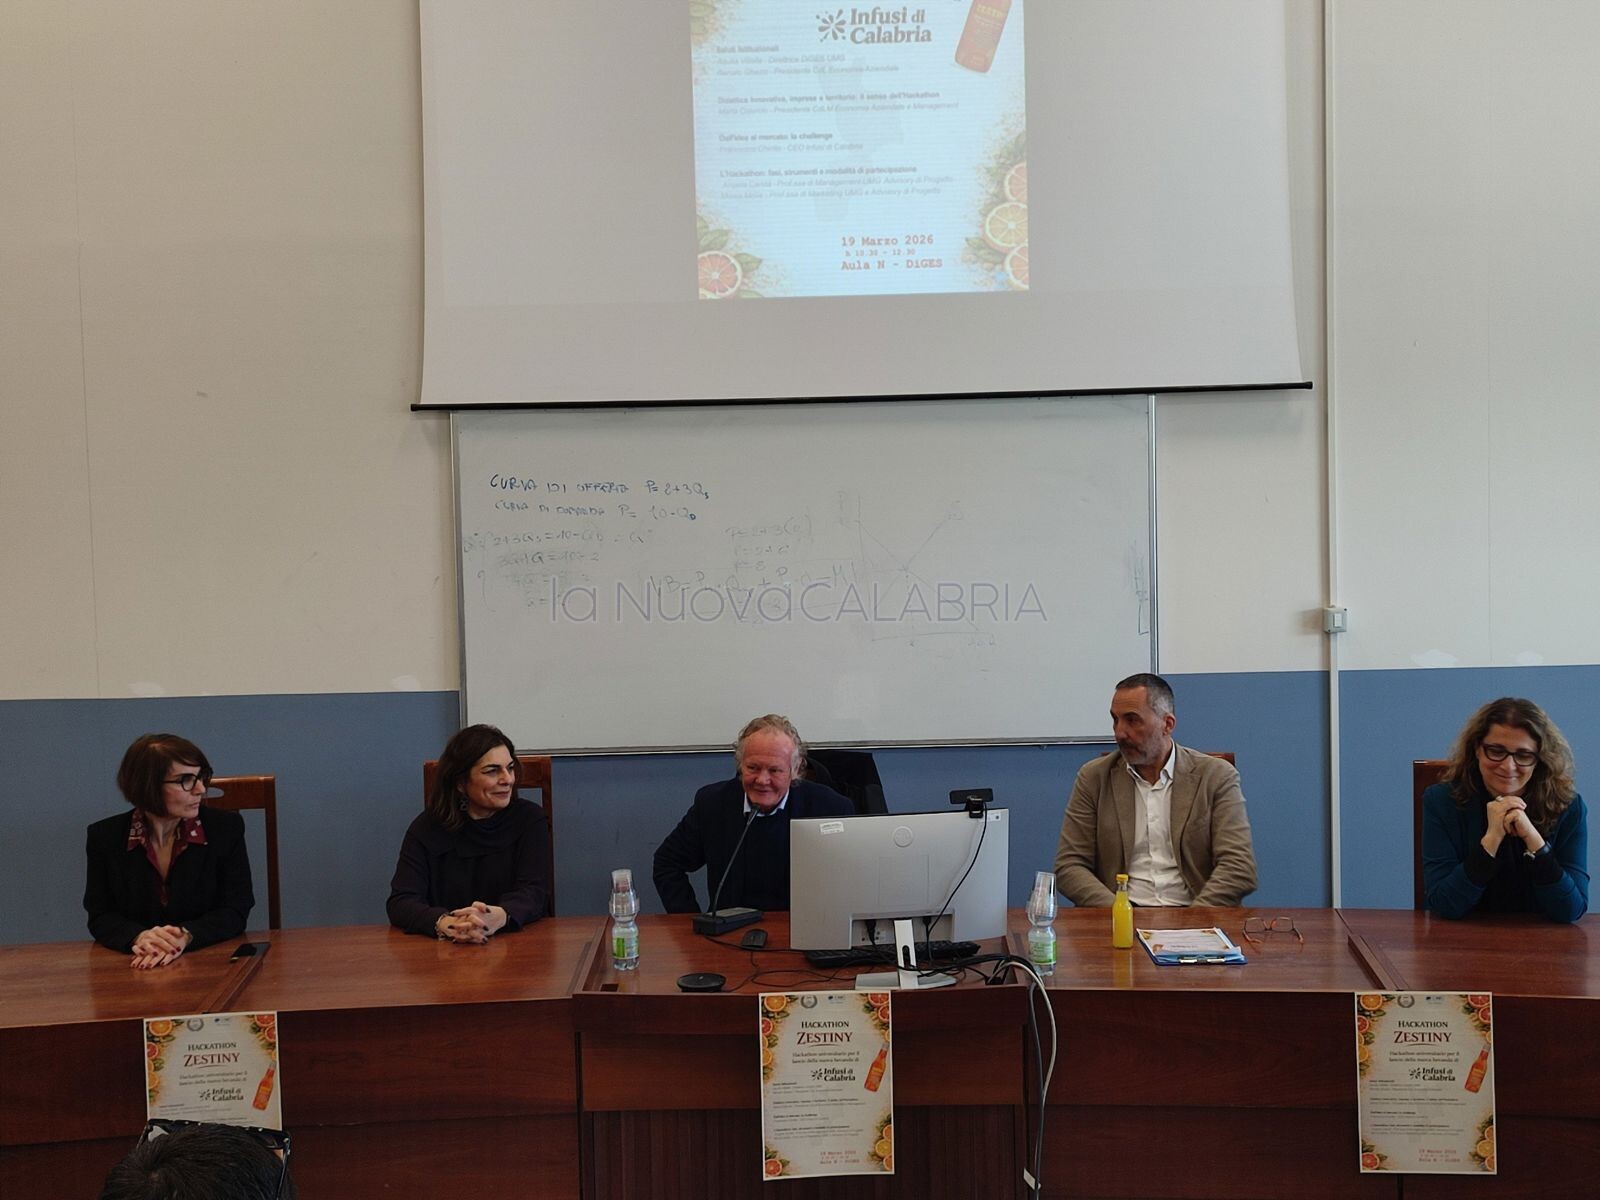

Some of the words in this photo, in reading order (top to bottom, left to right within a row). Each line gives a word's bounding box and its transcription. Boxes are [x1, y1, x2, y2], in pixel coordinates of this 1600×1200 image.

[850, 6, 907, 25] Infusi
[911, 9, 925, 23] di
[850, 25, 932, 44] Calabria
[799, 132, 833, 141] challenge
[865, 165, 917, 175] partecipazione
[842, 236, 856, 247] 19
[861, 236, 898, 246] Marzo
[904, 233, 934, 245] 2026
[841, 260, 870, 271] Aula
[906, 257, 943, 269] DiGES
[490, 473, 538, 492] CURVA
[577, 481, 630, 494] OFFERTA
[801, 1020, 850, 1029] HACKATHON
[1398, 1020, 1449, 1029] HACKATHON
[797, 1031, 853, 1046] ZESTINY
[1393, 1030, 1452, 1044] ZESTINY
[188, 1042, 237, 1051] HACKATHON
[183, 1052, 240, 1067] ZESTINY
[823, 1067, 847, 1075] Infusi
[1422, 1067, 1446, 1075] Infusi
[824, 1074, 856, 1082] Calabria
[212, 1087, 235, 1095] Infusi
[212, 1094, 244, 1102] Calabria
